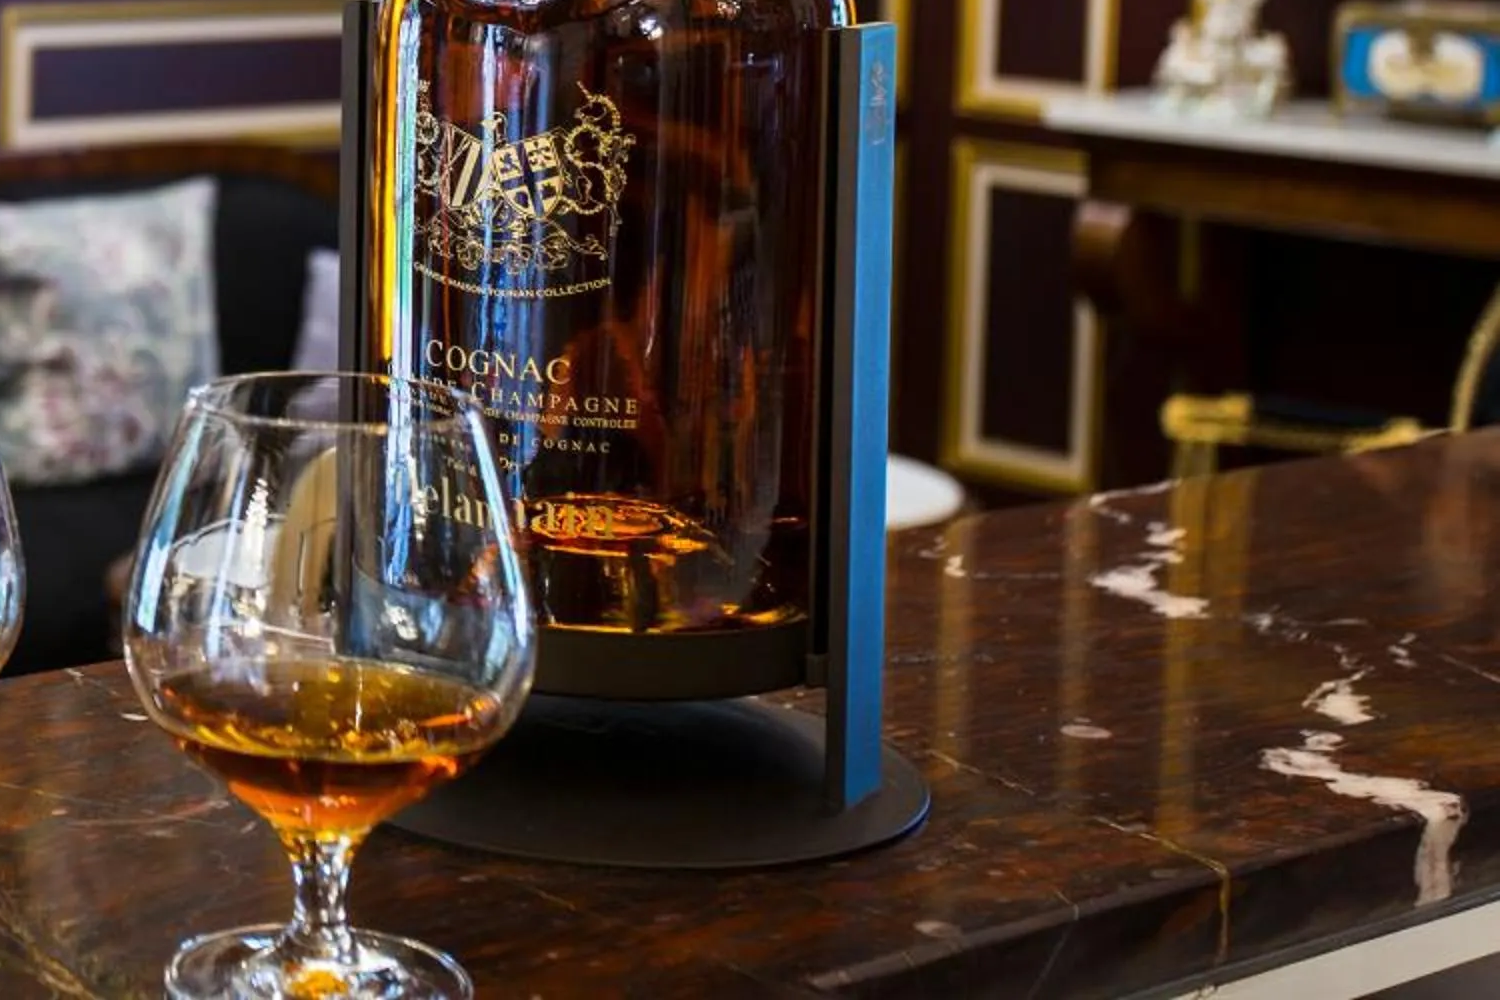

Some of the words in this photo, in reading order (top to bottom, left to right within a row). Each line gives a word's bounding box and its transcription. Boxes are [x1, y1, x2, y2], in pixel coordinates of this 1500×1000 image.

[536, 277, 612, 297] COLLECTION
[426, 339, 571, 385] COGNAC
[471, 382, 638, 415] CHAMPAGNE
[531, 438, 611, 454] COGNAC
